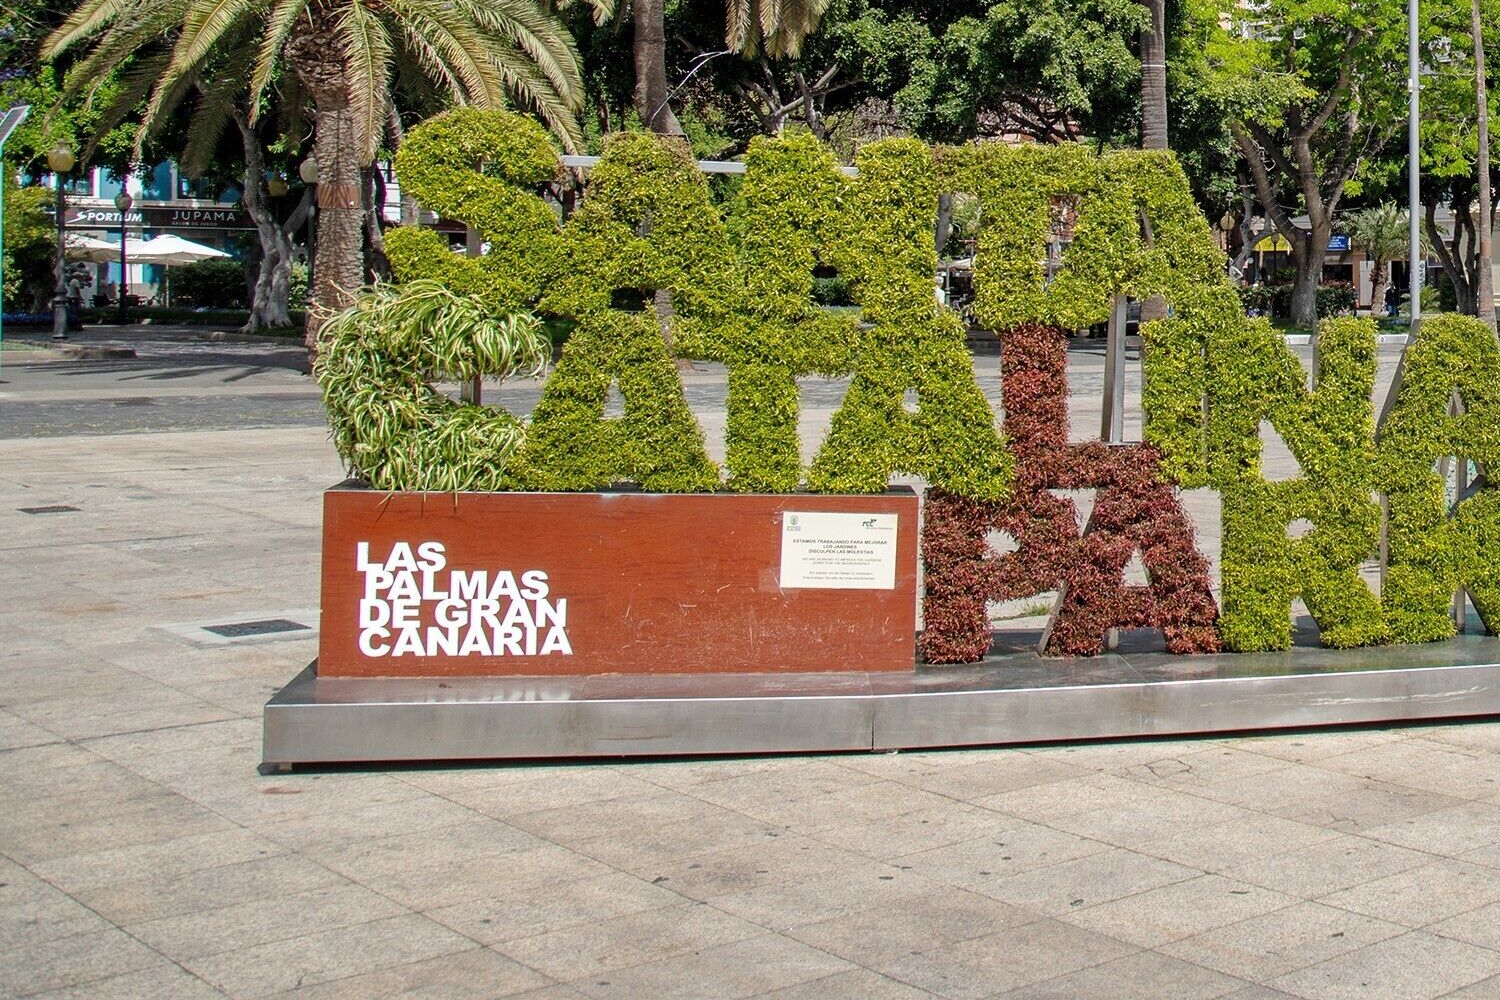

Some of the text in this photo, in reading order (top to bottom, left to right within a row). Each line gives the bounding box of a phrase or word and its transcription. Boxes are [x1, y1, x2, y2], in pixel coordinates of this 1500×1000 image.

[172, 210, 236, 221] JUPAMA
[383, 105, 1229, 330] SANTA
[356, 541, 447, 572] LAS
[364, 563, 550, 600] PALMAS
[359, 598, 567, 629] DE GRAN
[358, 626, 574, 657] CANARIA
